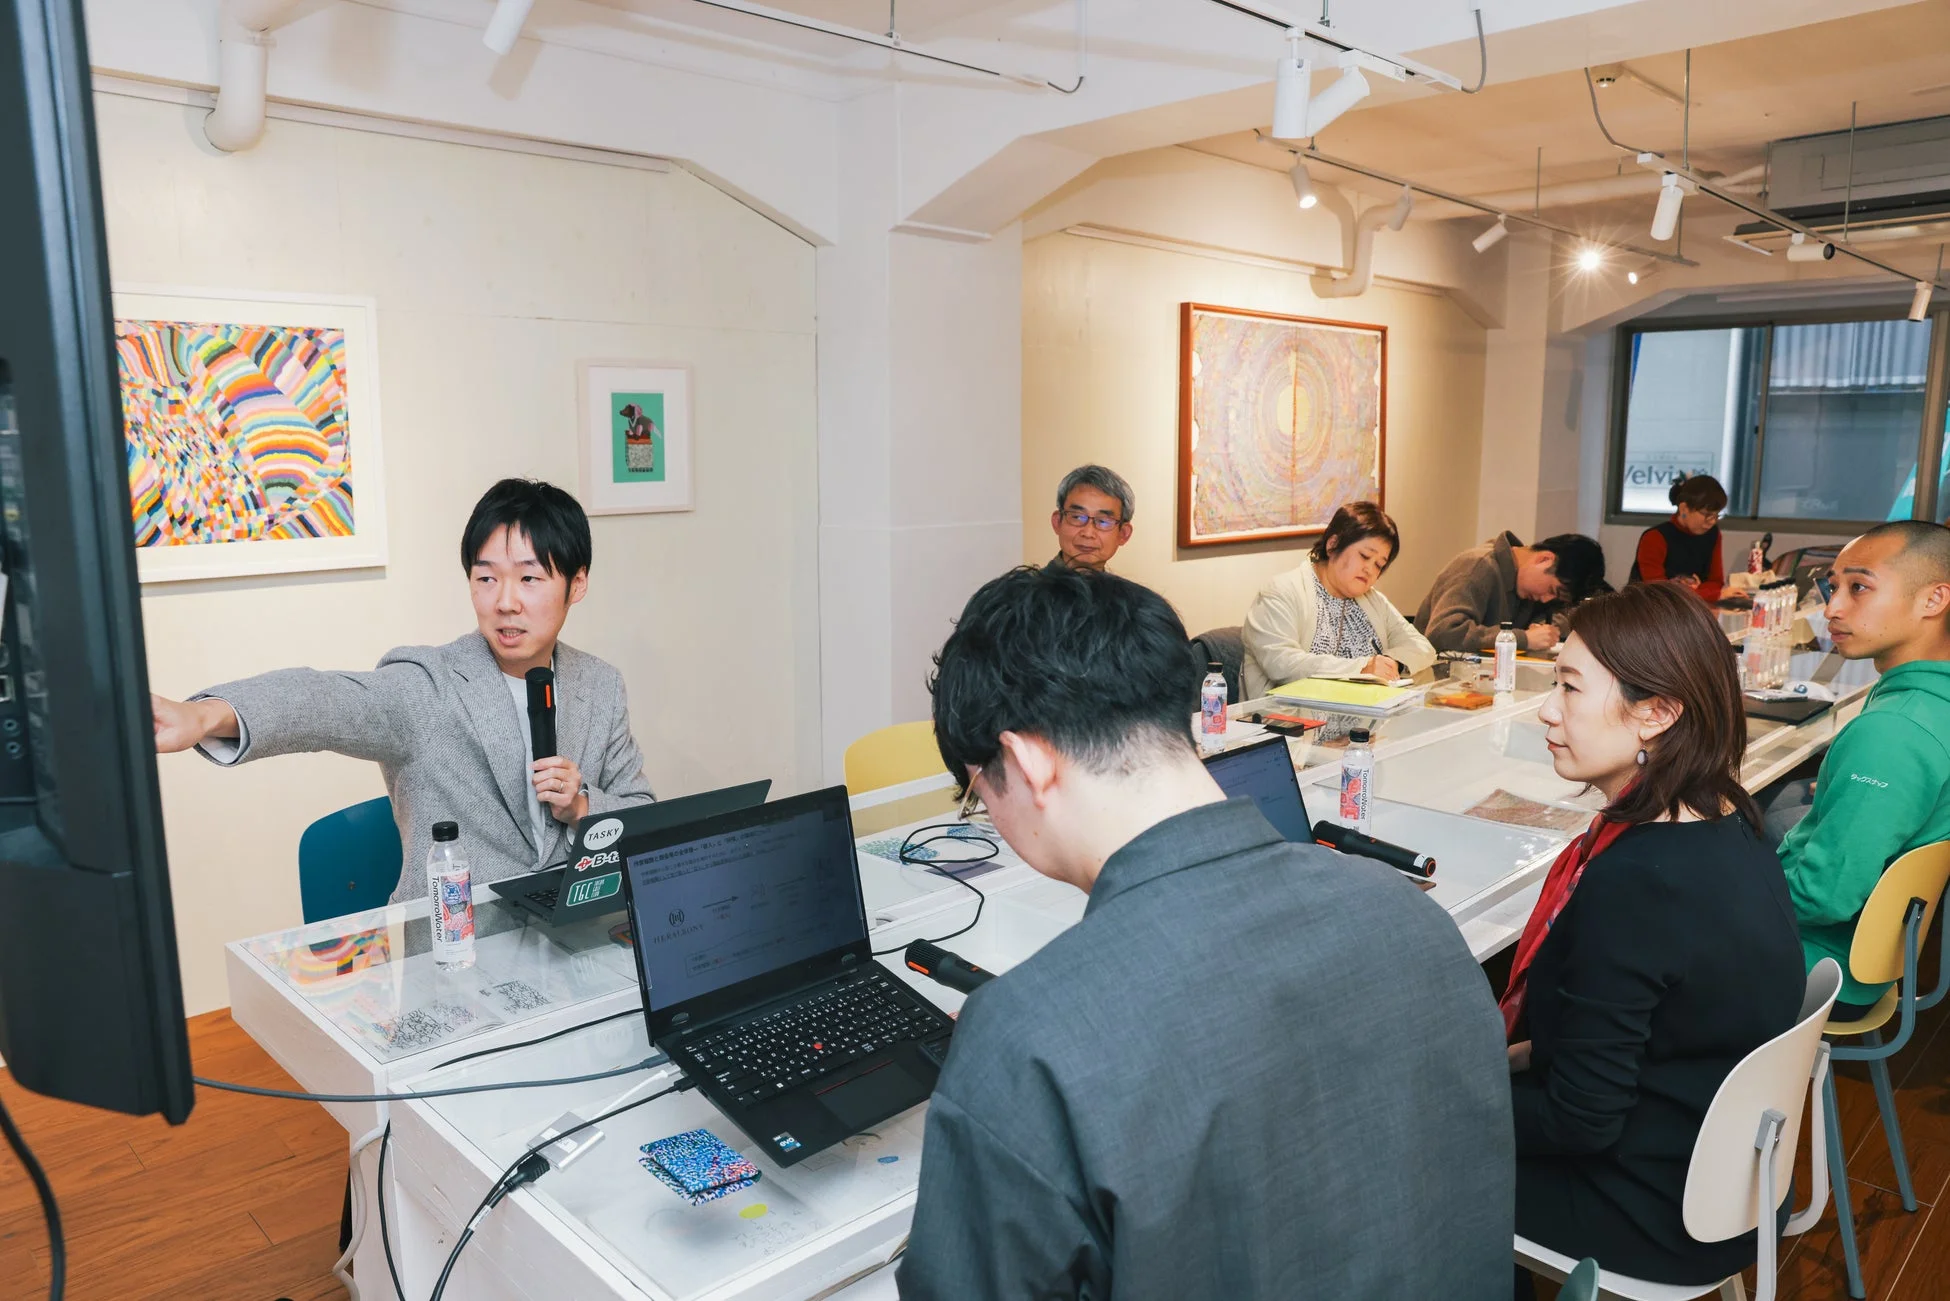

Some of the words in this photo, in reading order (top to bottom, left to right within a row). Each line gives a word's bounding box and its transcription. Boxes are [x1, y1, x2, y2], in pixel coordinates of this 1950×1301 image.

[588, 826, 620, 841] TASKY
[573, 881, 593, 902] TGC
[431, 876, 443, 943] TomorroWater
